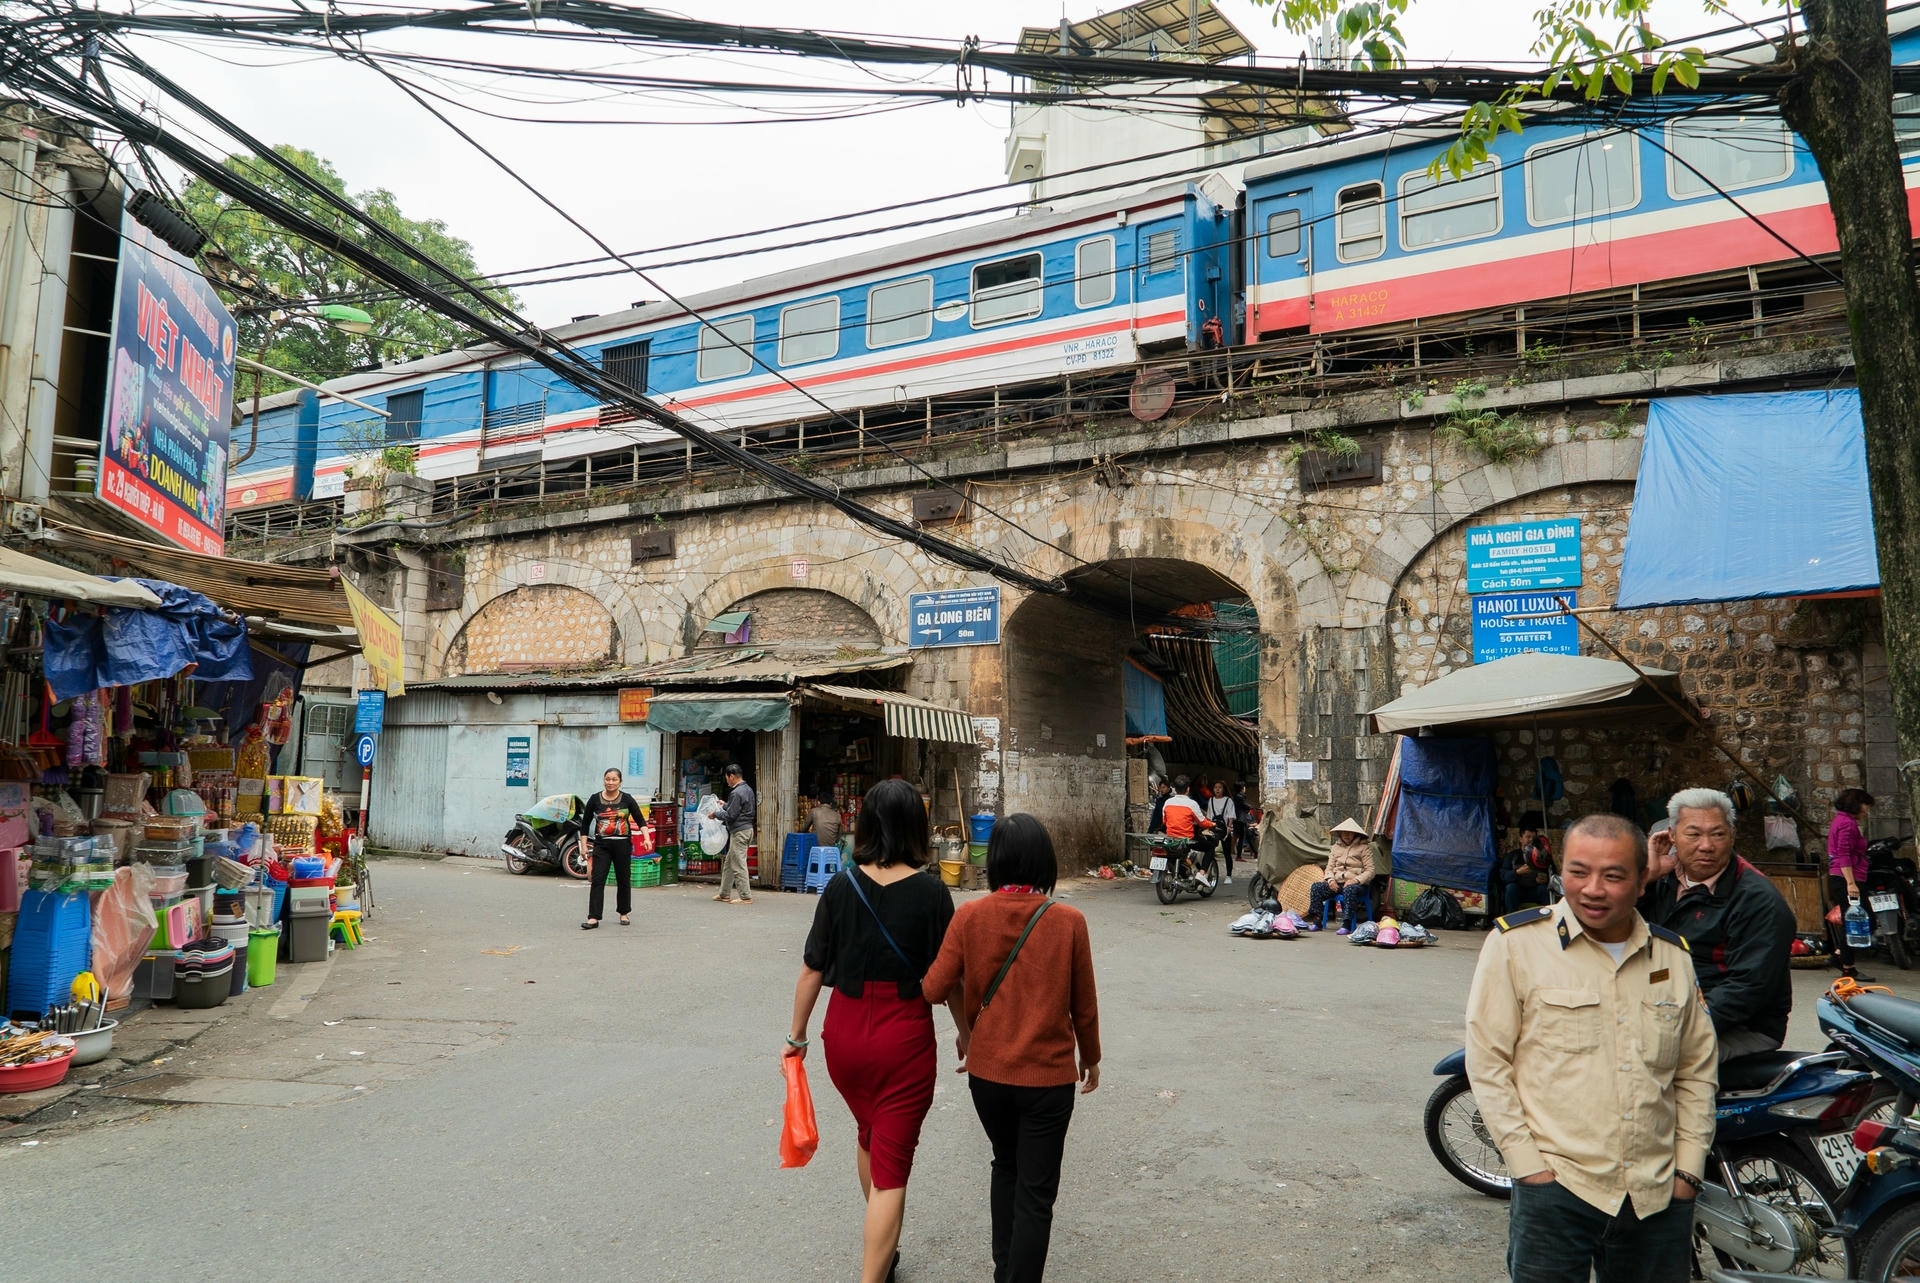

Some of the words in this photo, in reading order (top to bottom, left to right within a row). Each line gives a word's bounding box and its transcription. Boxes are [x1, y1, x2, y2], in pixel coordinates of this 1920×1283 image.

[1331, 289, 1388, 308] HARACO
[1336, 311, 1344, 320] A
[1349, 304, 1386, 318] 31437
[138, 279, 179, 372] VIỆT
[180, 335, 223, 421] NHẬT
[1064, 343, 1079, 353] VNR
[1086, 336, 1117, 349] HARACO
[150, 454, 183, 499] DOANH
[1471, 530, 1494, 546] NHÀ
[1525, 529, 1544, 541] GIA
[1546, 524, 1575, 539] ĐÌNH
[1492, 548, 1520, 557] FAMILY
[1522, 545, 1553, 554] HOSTEL
[1482, 579, 1507, 589] Cách
[1510, 578, 1531, 587] 50m
[1478, 598, 1518, 614] HANOI
[917, 612, 931, 626] GA
[934, 611, 962, 624] LONG
[966, 606, 991, 622] BIÊN
[1480, 618, 1515, 628] HOUSE
[1518, 618, 1526, 627] &
[1500, 635, 1512, 643] 50
[1515, 634, 1546, 642] METER
[1822, 1133, 1857, 1159] 29-P
